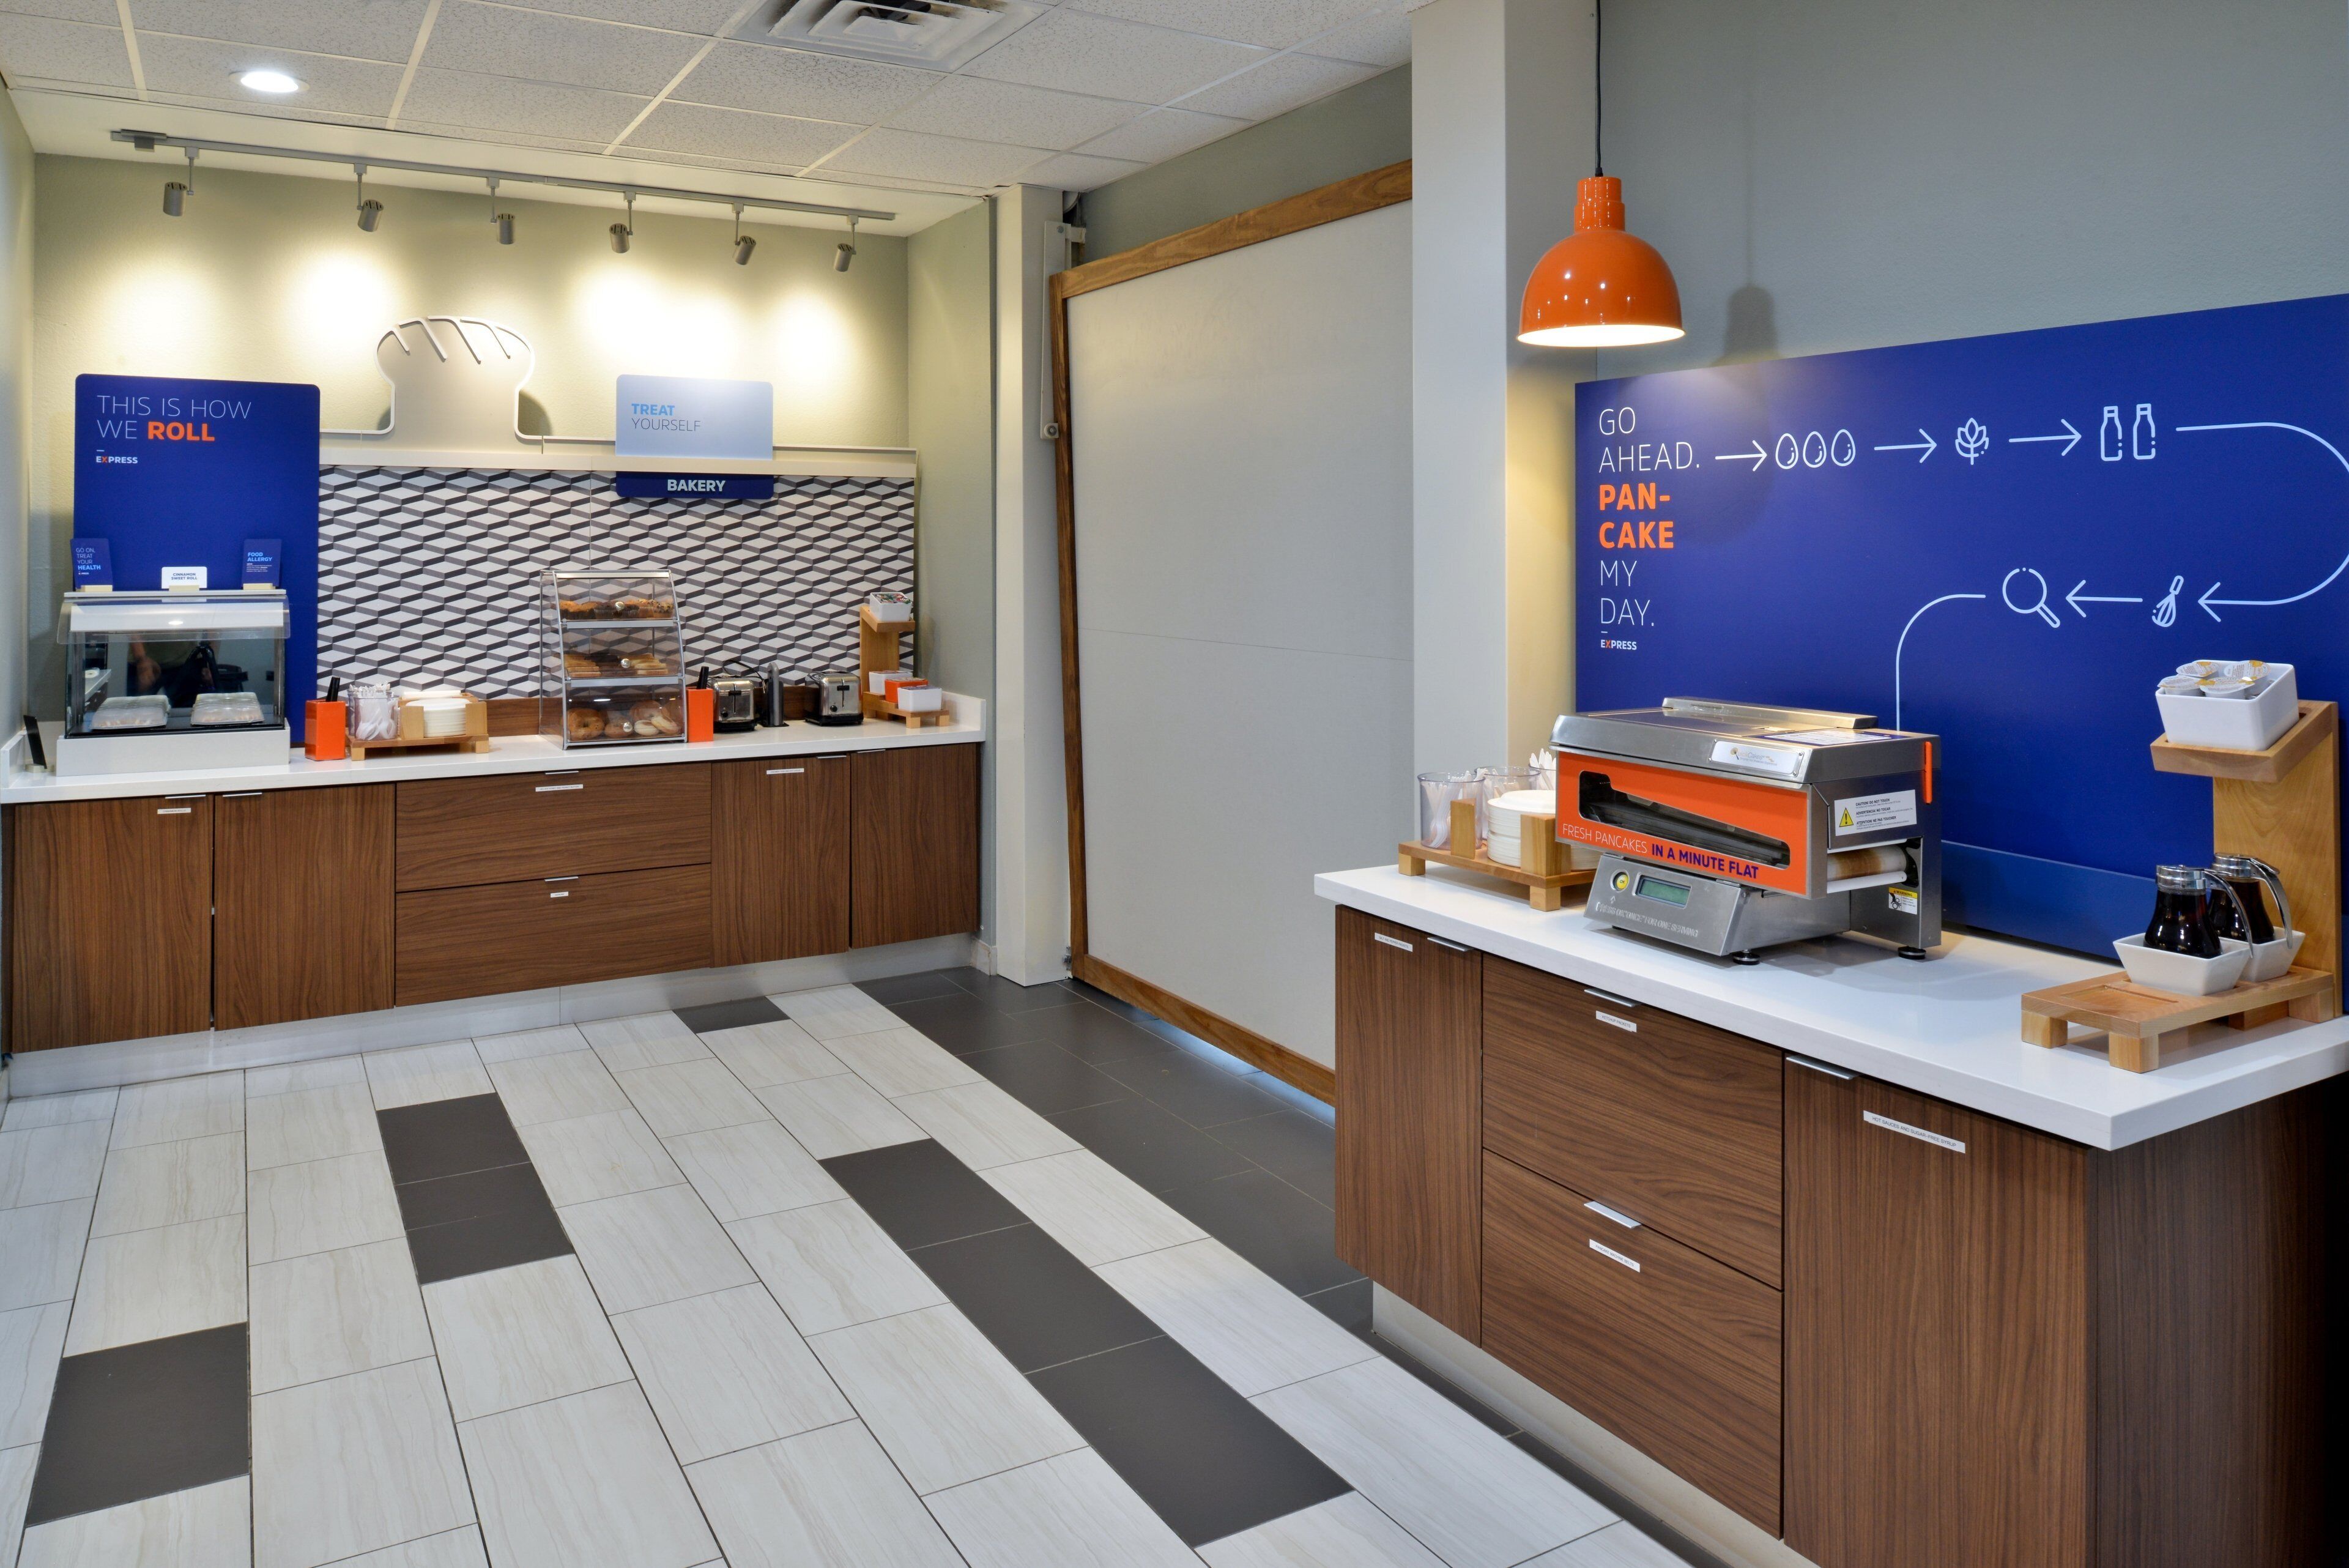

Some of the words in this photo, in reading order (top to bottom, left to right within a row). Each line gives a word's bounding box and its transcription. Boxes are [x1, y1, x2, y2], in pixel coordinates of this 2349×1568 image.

[97, 395, 150, 415] THIS
[162, 398, 180, 416] IS
[191, 399, 251, 418] HOW
[631, 403, 675, 416] TREAT
[97, 420, 137, 439] WE
[148, 422, 215, 441] ROLL
[631, 418, 700, 431] YOURSELF
[1599, 407, 1635, 435] GO
[1599, 442, 1699, 473] AHEAD.
[667, 479, 725, 492] BAKERY
[1600, 483, 1670, 511] PAN-
[1599, 521, 1674, 548] CAKE
[1601, 560, 1637, 587] MY
[1601, 598, 1654, 626] DAY.
[1600, 639, 1637, 650] EXPRESS
[1563, 823, 1592, 841] FRESH
[1595, 831, 1647, 853] PANCAKES
[1652, 844, 1663, 857] IN
[1667, 847, 1675, 860] A
[1679, 850, 1724, 871] MINUTE
[1729, 861, 1759, 879] FLAT
[1882, 1120, 1899, 1129] SAUCES
[1911, 1129, 1940, 1142] SUGAR-FREE
